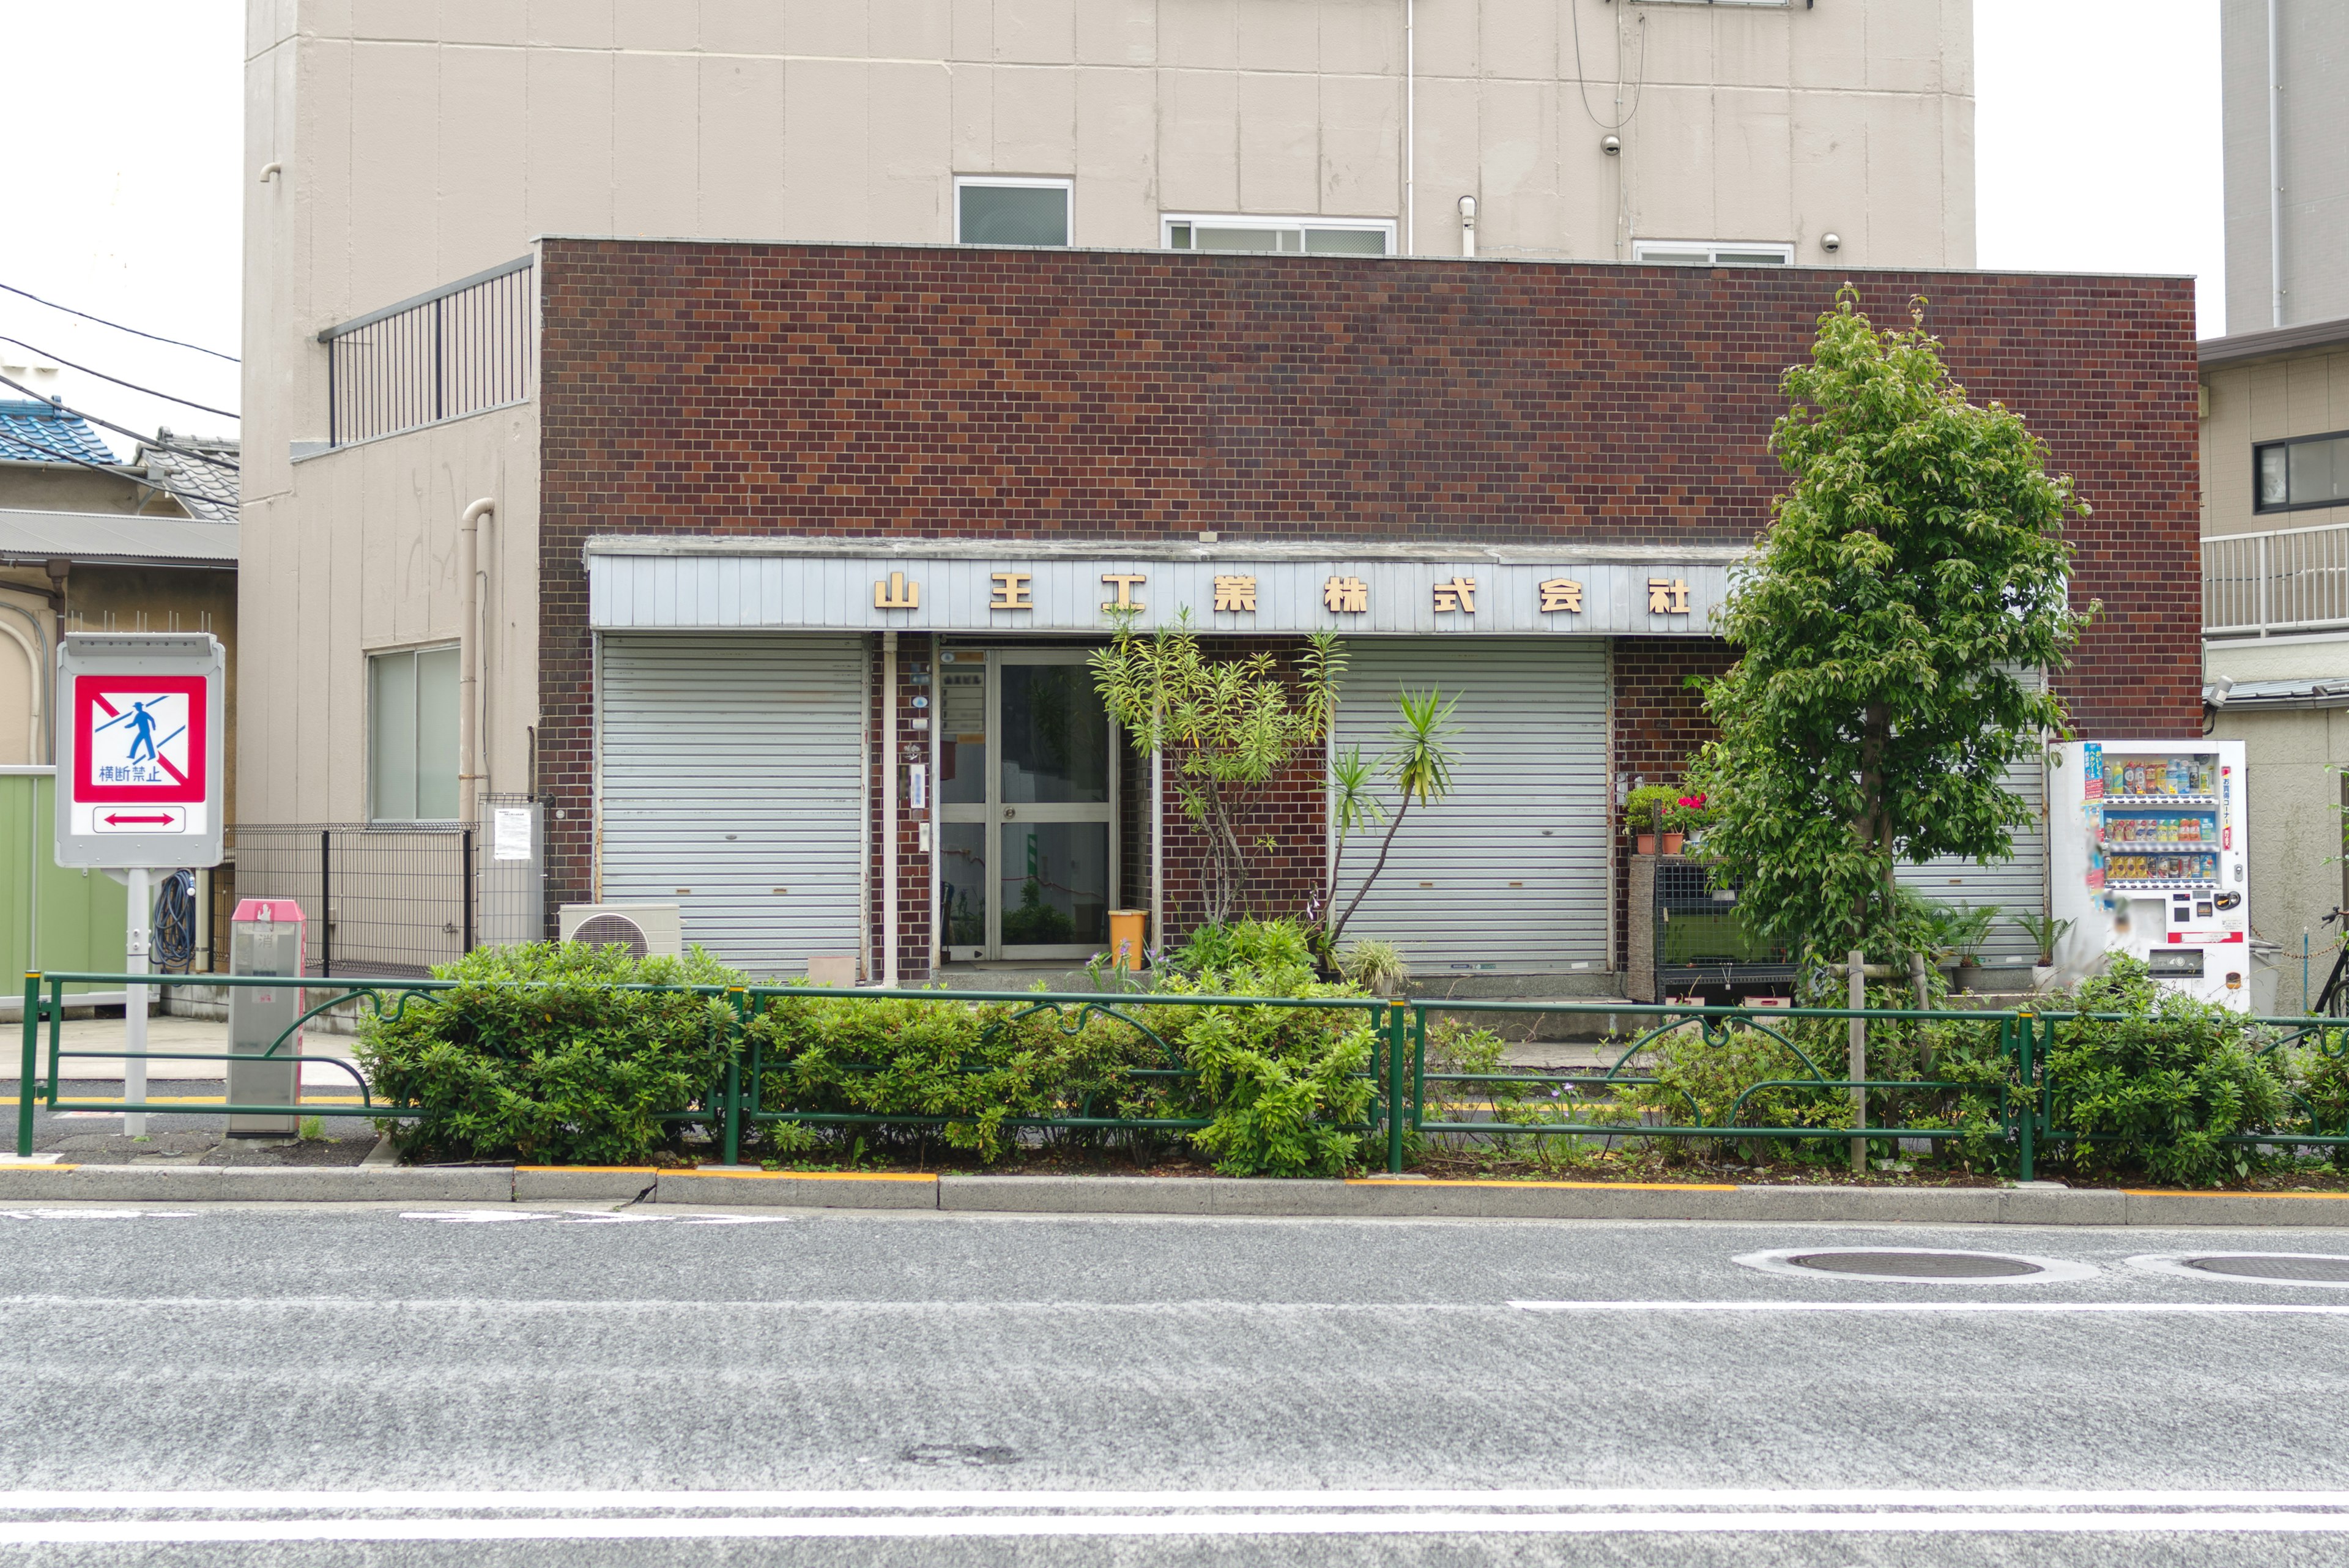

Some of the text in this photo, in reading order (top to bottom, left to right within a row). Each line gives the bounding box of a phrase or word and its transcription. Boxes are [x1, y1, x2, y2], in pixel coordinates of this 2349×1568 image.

[874, 572, 1690, 614] 山王工業株式会社
[99, 765, 162, 782] 横断禁止
